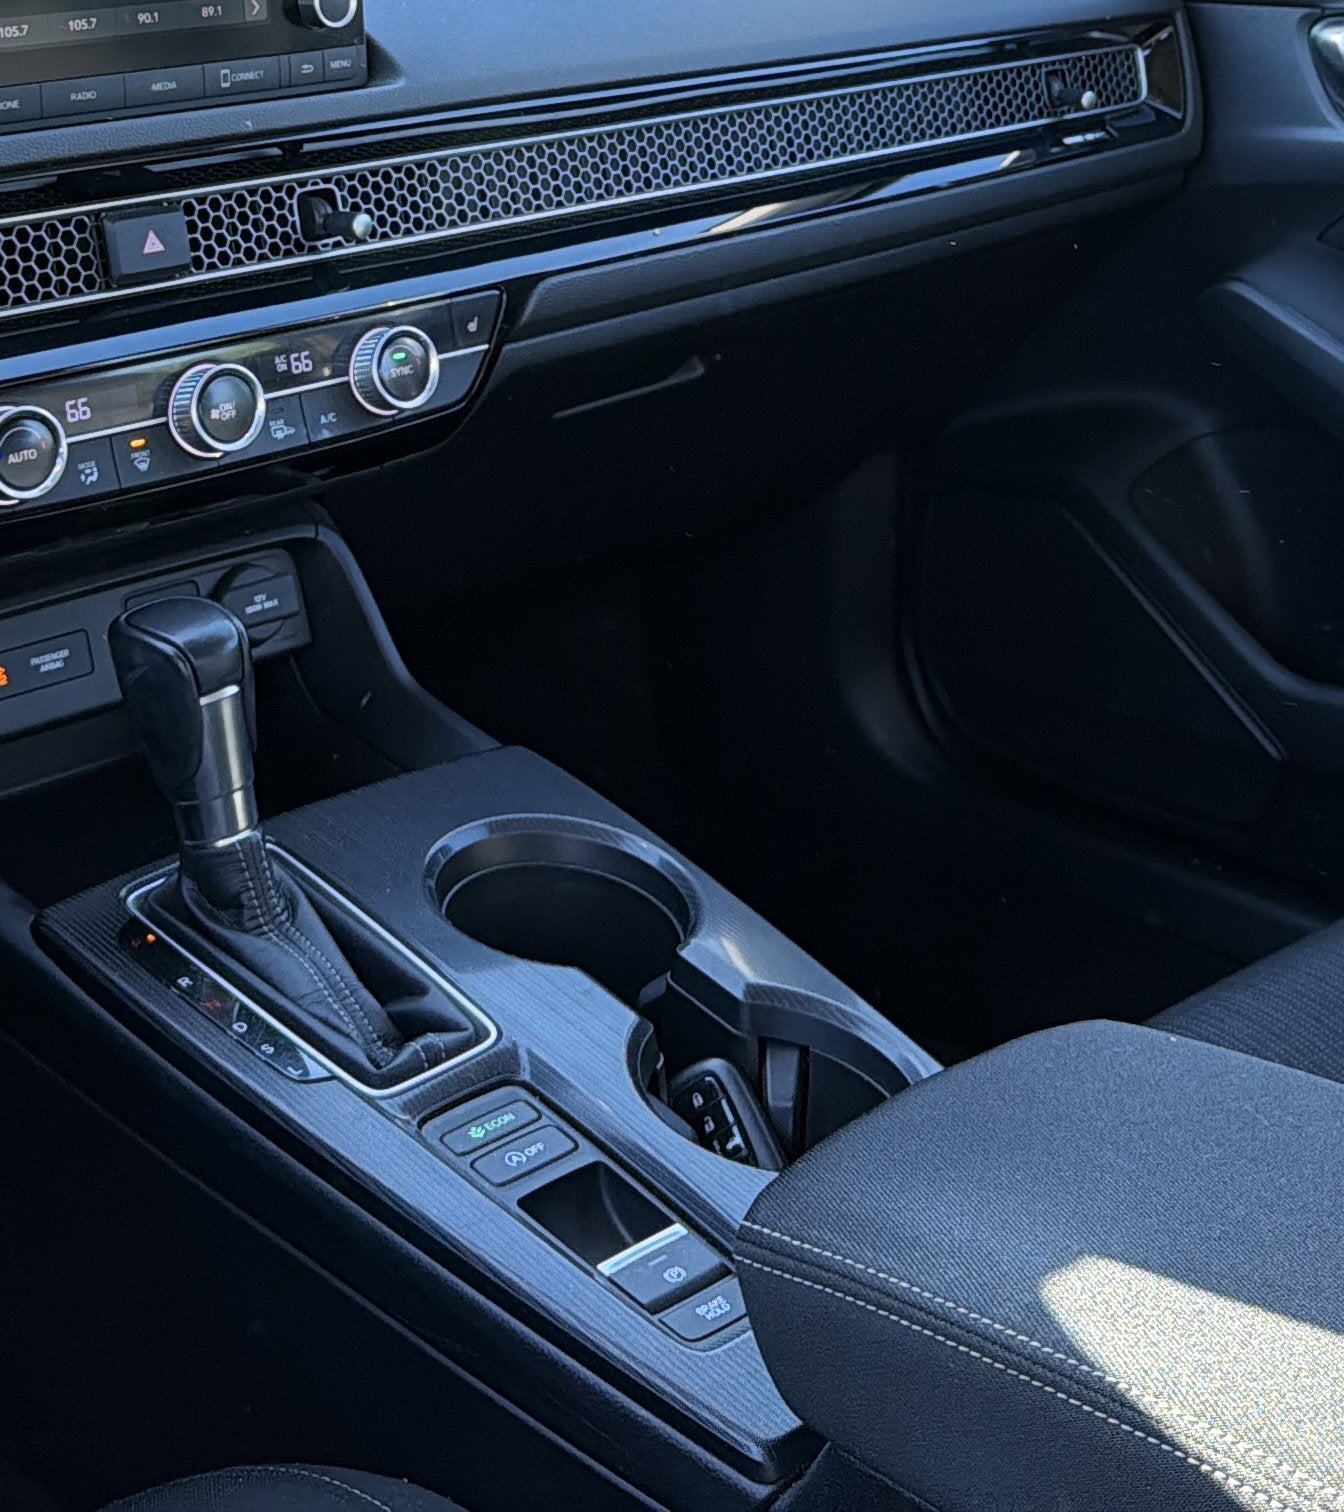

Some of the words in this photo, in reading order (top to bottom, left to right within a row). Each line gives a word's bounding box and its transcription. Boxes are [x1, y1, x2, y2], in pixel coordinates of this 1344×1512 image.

[201, 5, 223, 18] 89.1
[68, 18, 97, 32] 105.7
[137, 12, 159, 25] 90.1
[329, 59, 352, 69] MENU
[231, 70, 265, 82] CONNECT
[150, 81, 178, 92] MEDIA
[70, 90, 97, 102] RADIO
[290, 350, 313, 375] 66
[390, 364, 415, 378] SYNC
[65, 397, 92, 423] 66
[220, 409, 237, 421] OFF
[320, 412, 338, 425] A/C
[8, 449, 38, 465] AUTO
[177, 976, 194, 989] R
[260, 1043, 275, 1055] S
[484, 1112, 516, 1131] ECON
[524, 1141, 545, 1157] OFF
[704, 1303, 731, 1321] HOLD
